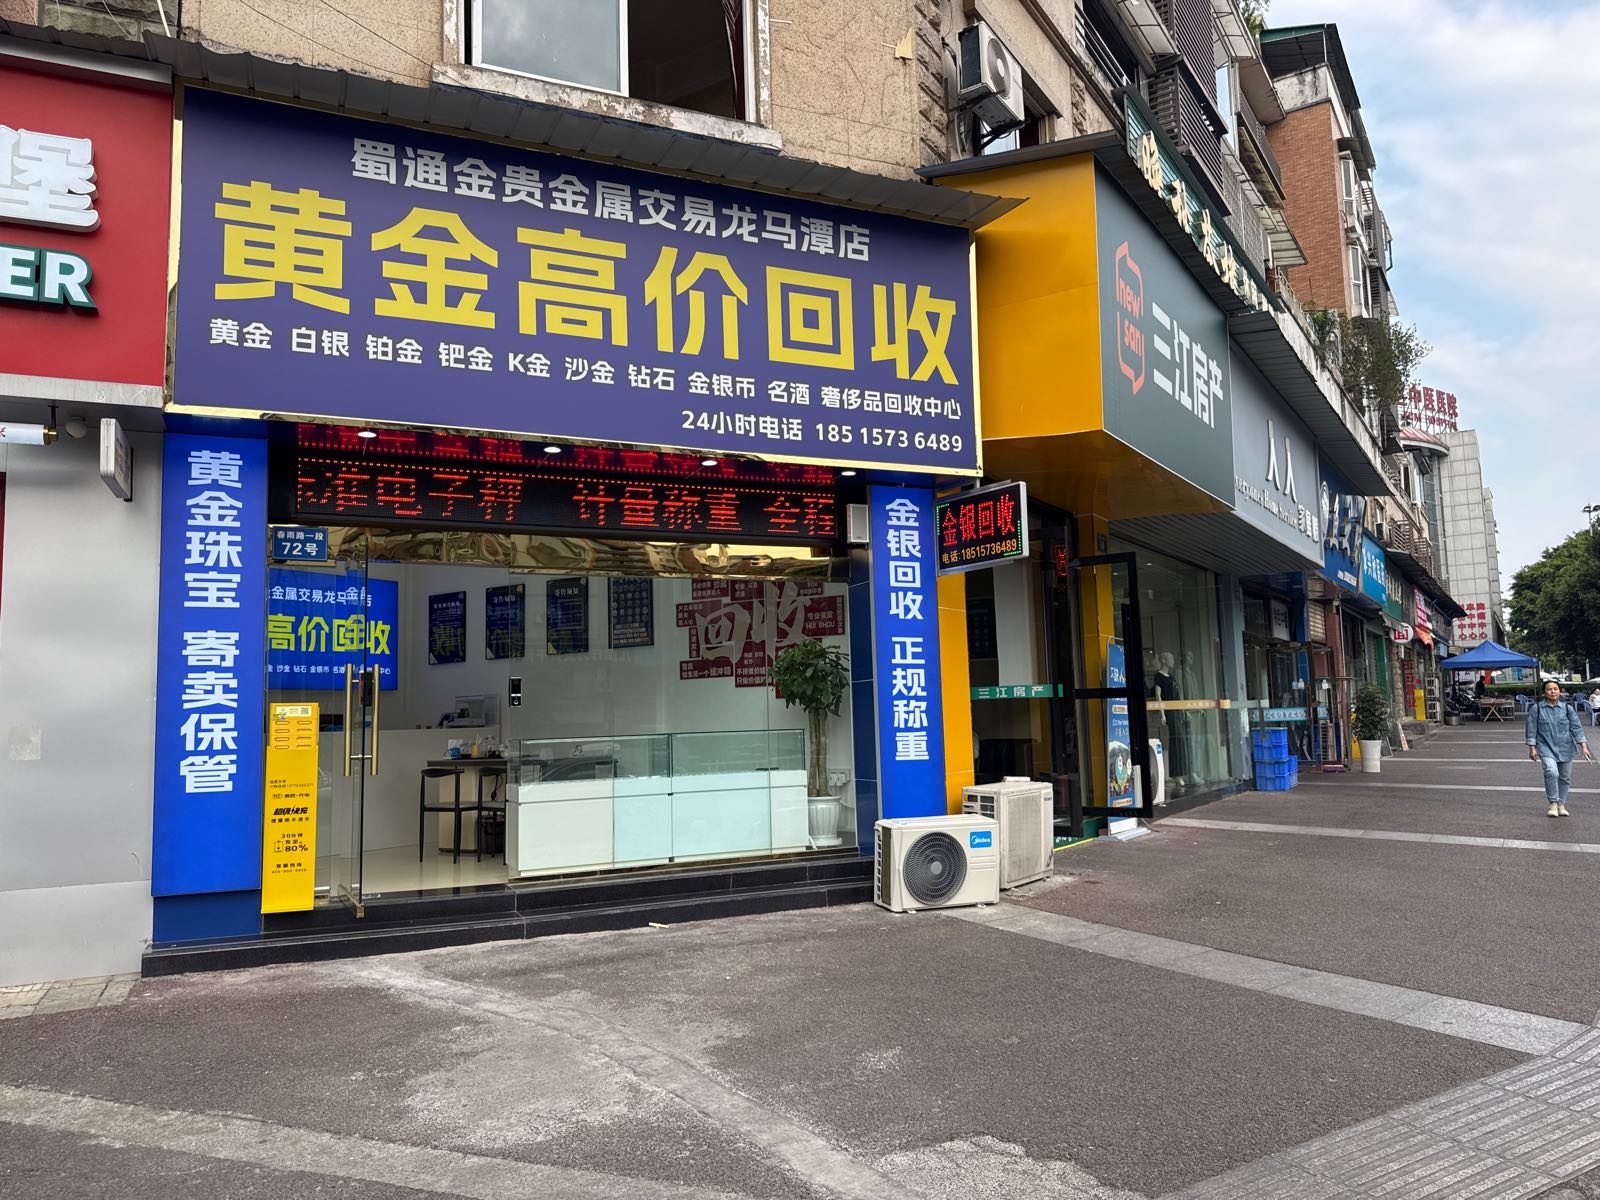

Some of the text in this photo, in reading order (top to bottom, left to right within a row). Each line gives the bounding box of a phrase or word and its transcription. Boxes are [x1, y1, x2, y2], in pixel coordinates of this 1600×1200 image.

[0, 125, 99, 230] 堡
[351, 137, 870, 262] 蜀通金贵金属交易龙马潭店
[0, 244, 96, 306] ER
[214, 180, 959, 386] 黄金高价回收
[1118, 277, 1140, 320] new
[209, 317, 962, 421] 黄金 白银 铂金 钯金 K金 沙金 钻石 金银币 名酒 奢侈品回收中心
[1152, 301, 1224, 430] 三江房产
[681, 410, 963, 453] 24小时电话 185 1573 6489
[572, 483, 743, 531] 计量称重
[942, 494, 1016, 546] 金银回收
[277, 530, 324, 541] 春雨路一段
[281, 542, 319, 556] 72号
[941, 538, 1017, 564] 电话:18515736489
[179, 449, 244, 794] 黄金珠宝 寄卖保管
[885, 498, 930, 761] 金银回收 正规称重
[978, 686, 1044, 699] 三江房产
[285, 844, 309, 852] 80%
